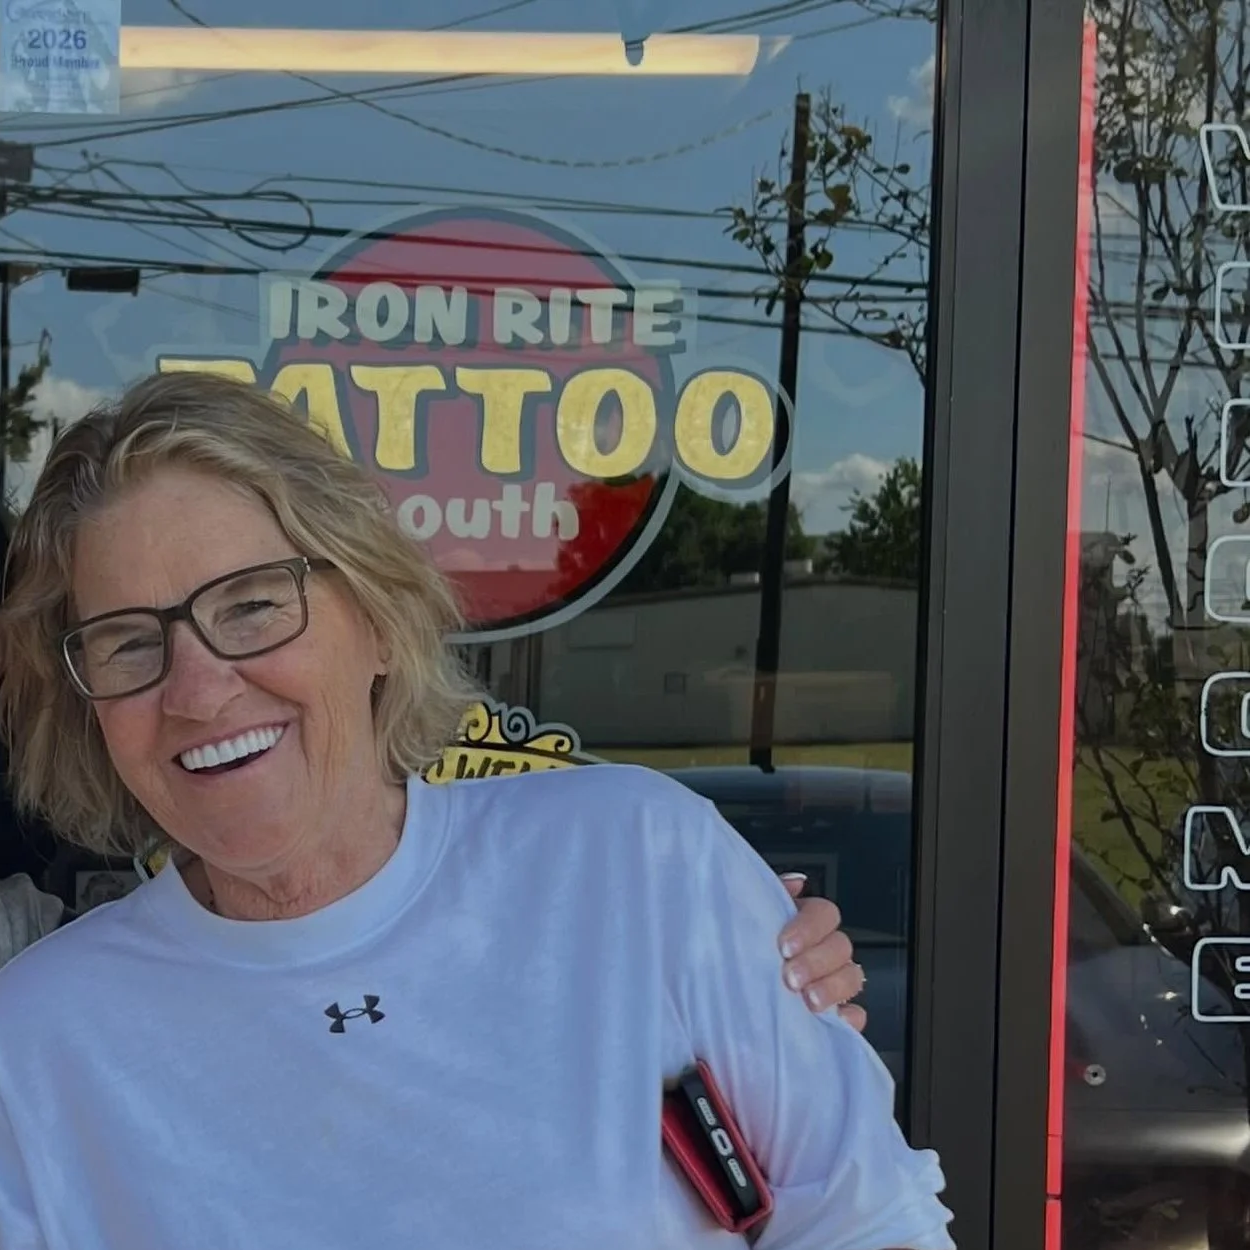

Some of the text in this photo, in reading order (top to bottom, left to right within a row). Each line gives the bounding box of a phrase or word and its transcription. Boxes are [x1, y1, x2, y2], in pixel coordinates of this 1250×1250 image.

[27, 28, 87, 50] 2026
[268, 279, 682, 346] IRON RITE
[397, 483, 580, 542] outh
